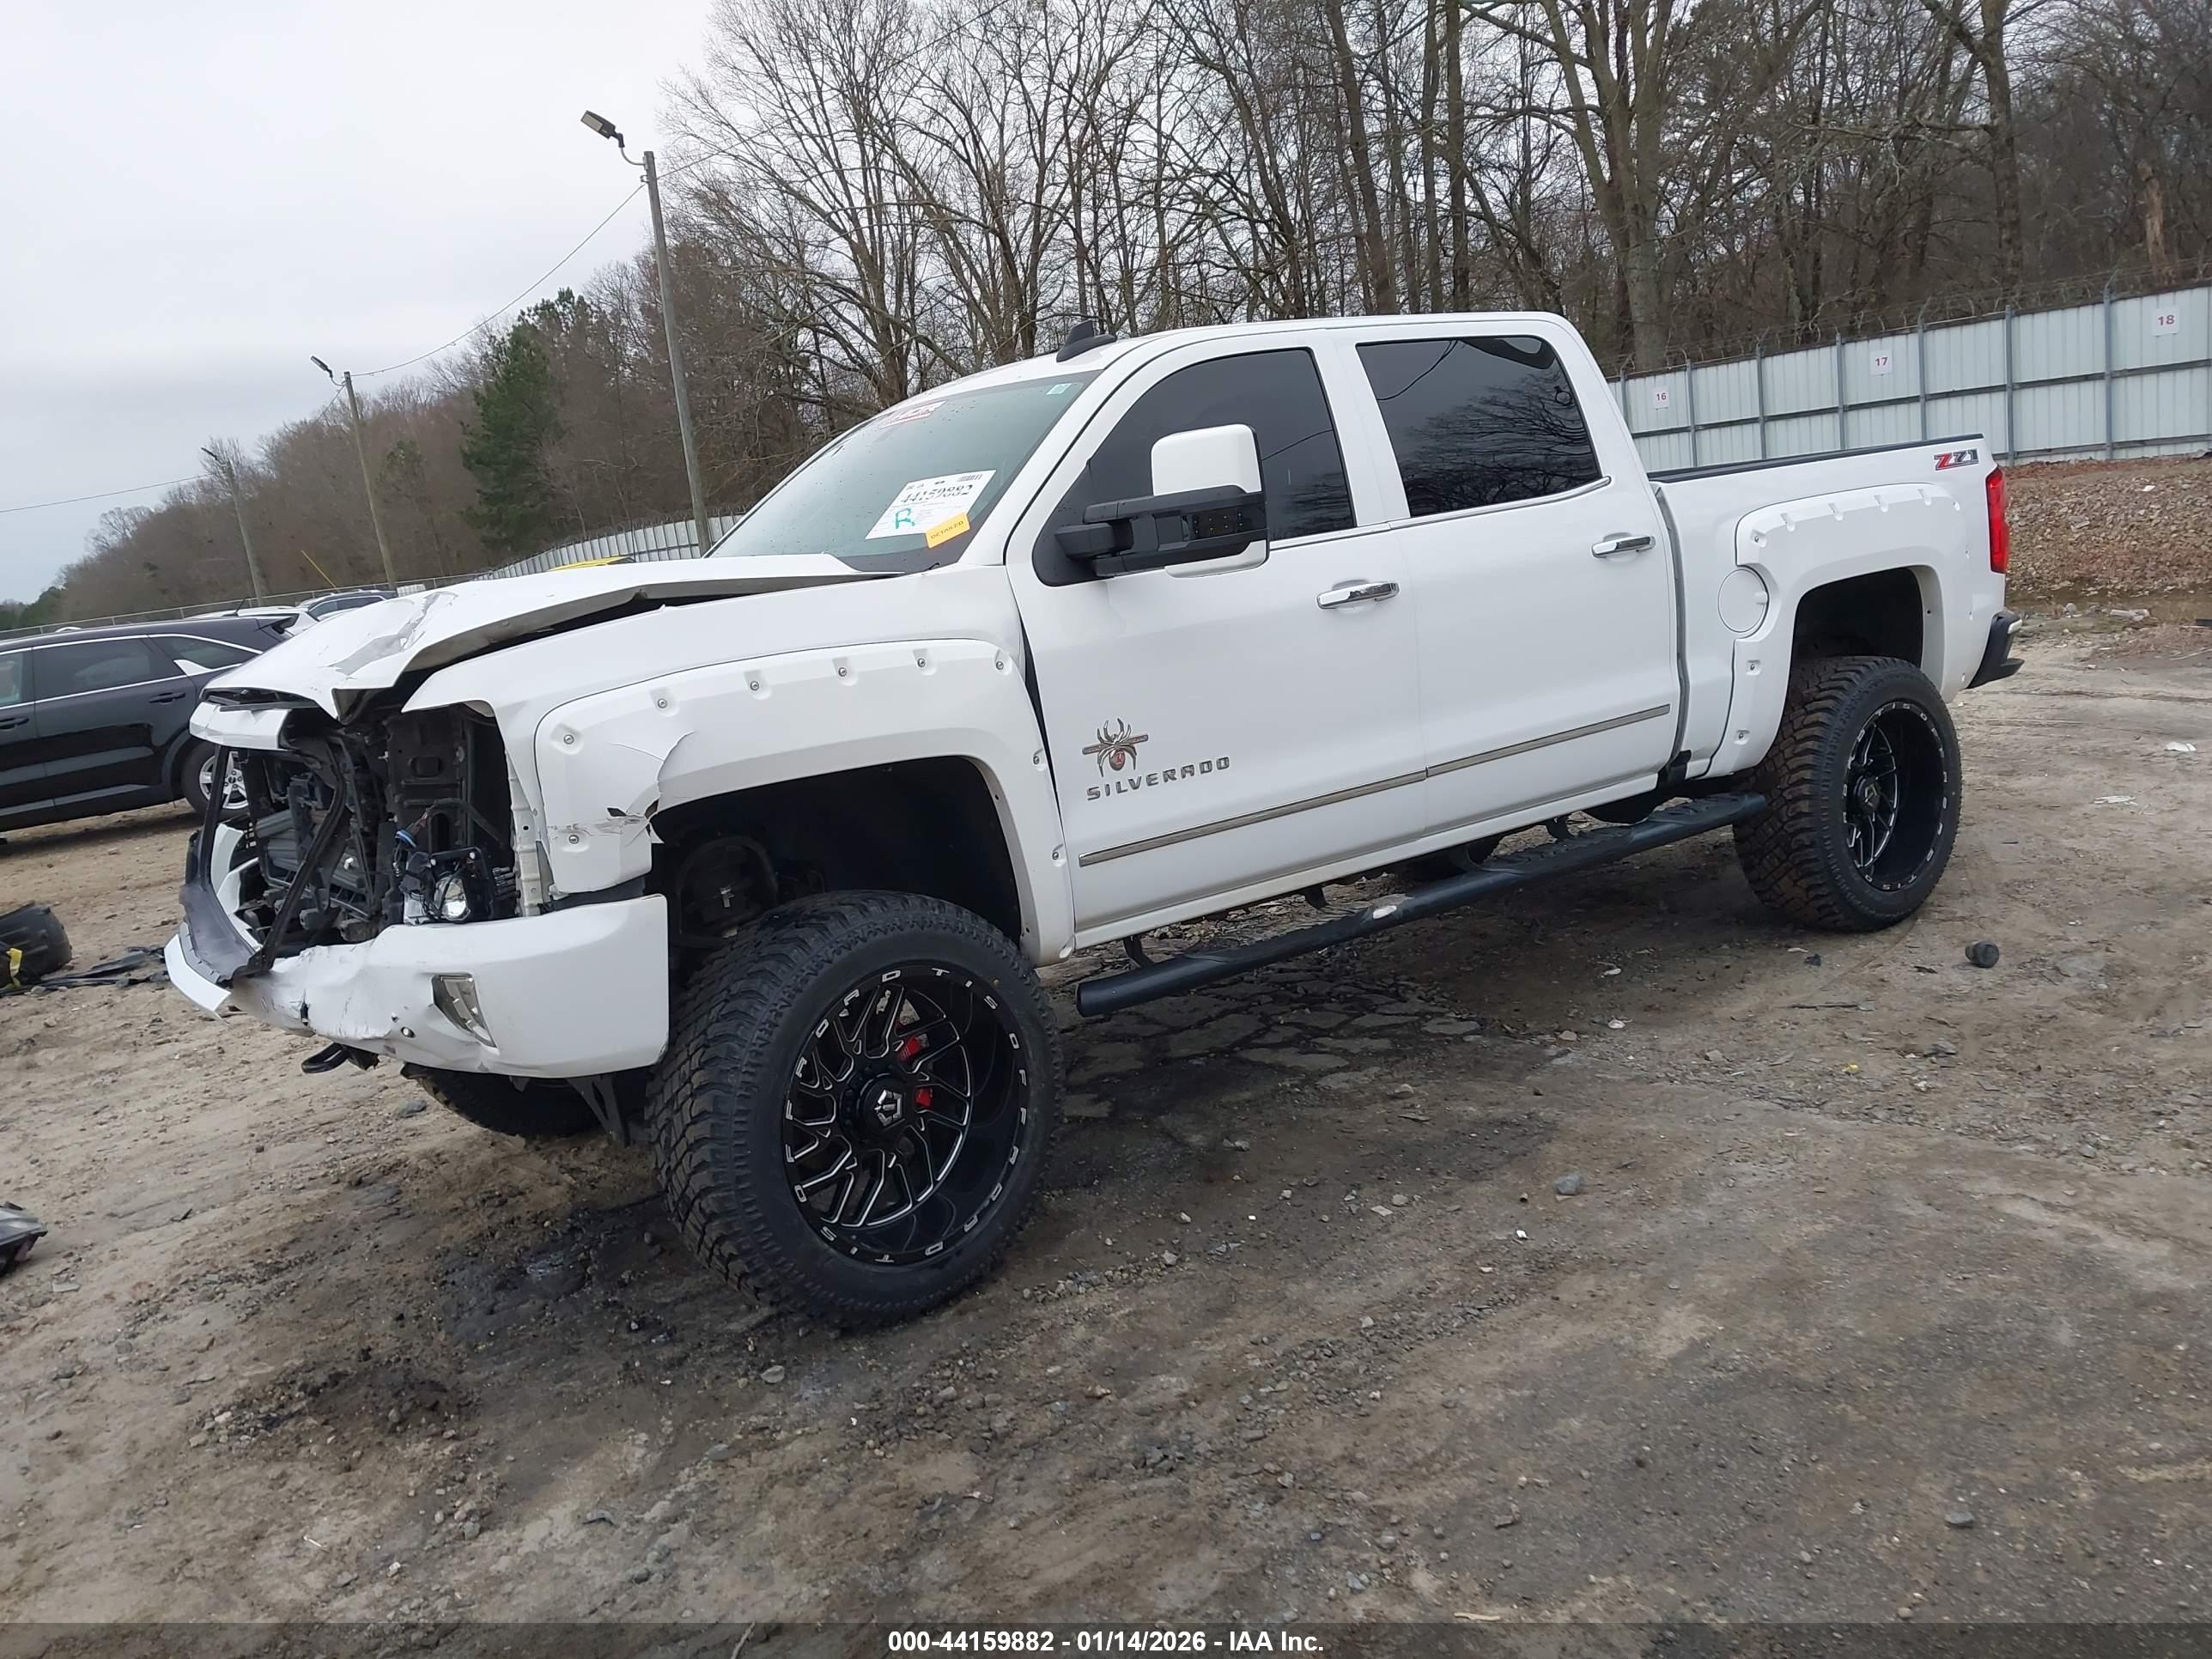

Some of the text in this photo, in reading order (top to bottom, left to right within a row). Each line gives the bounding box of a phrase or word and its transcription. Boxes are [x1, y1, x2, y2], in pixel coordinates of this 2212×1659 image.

[2157, 314, 2175, 326] 18
[1875, 356, 1888, 367] 17
[1656, 392, 1667, 401] 16
[1933, 448, 1979, 471] Z71
[1085, 756, 1231, 801] SILVERADO
[931, 966, 999, 1010] TIS
